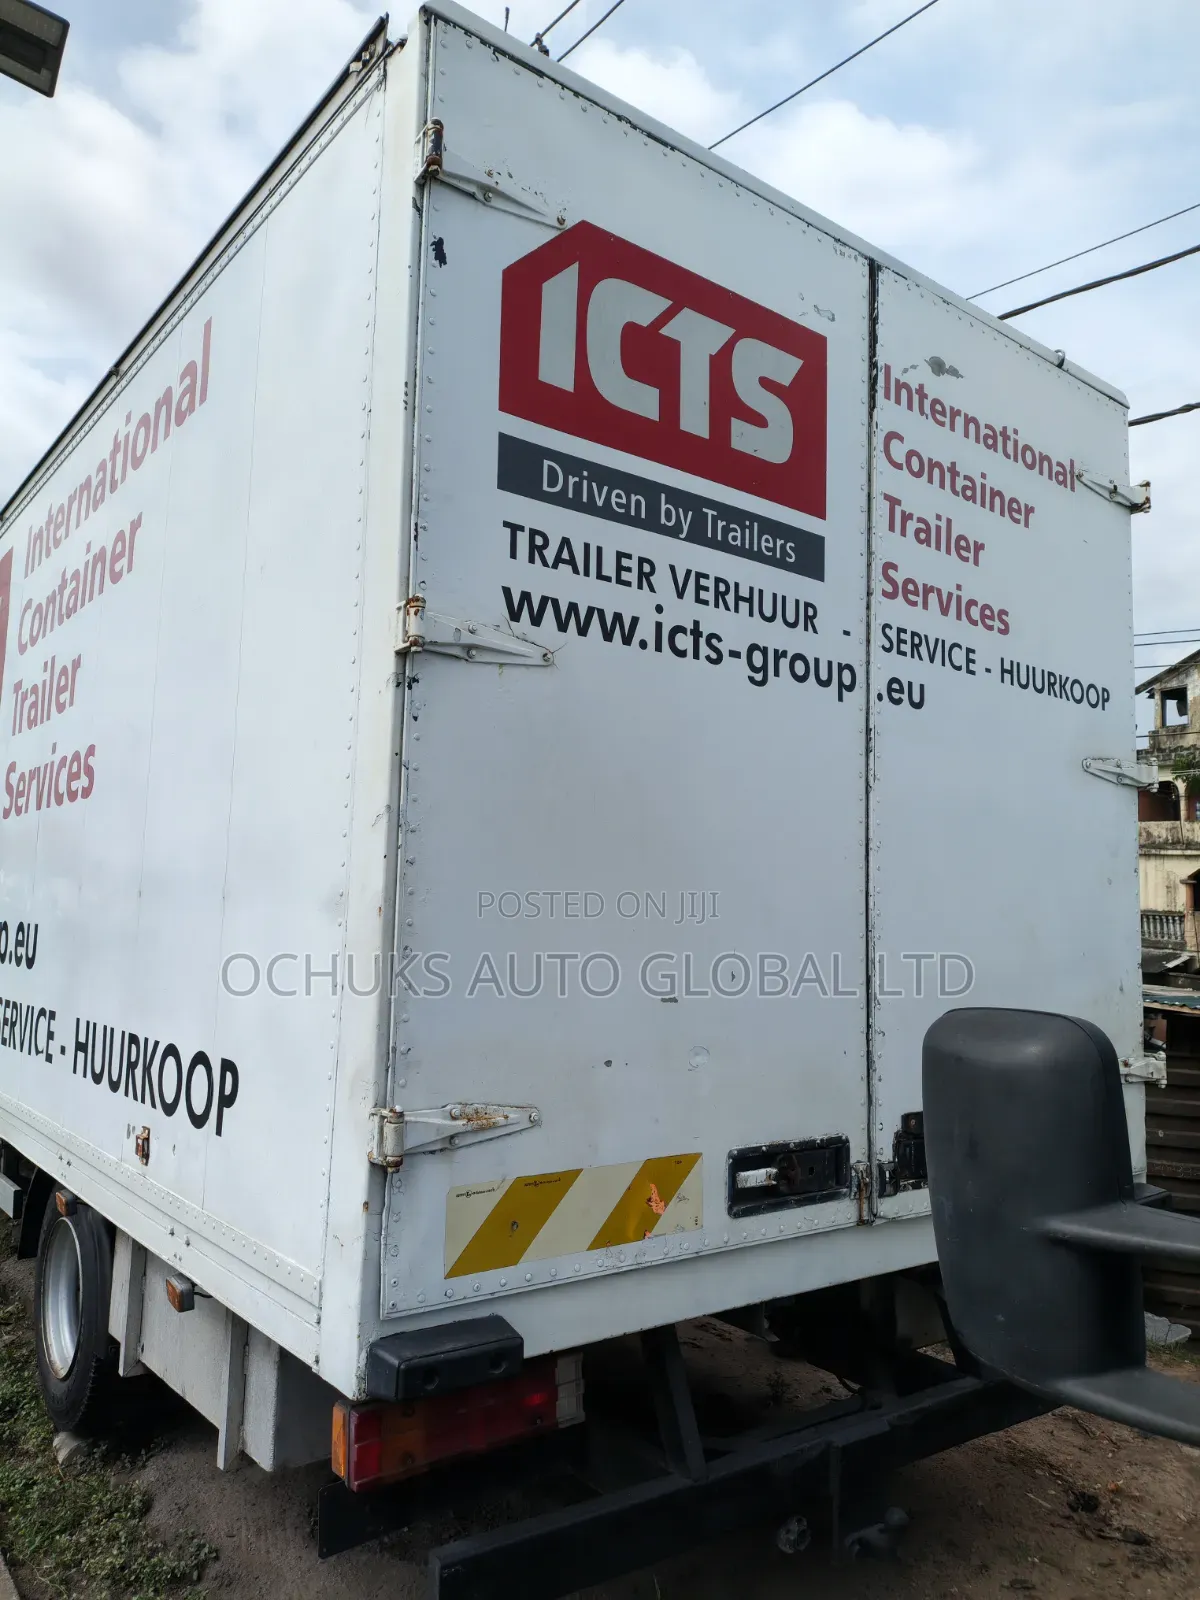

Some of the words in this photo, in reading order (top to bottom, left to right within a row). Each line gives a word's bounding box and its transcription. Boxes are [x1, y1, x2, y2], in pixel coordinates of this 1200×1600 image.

[538, 261, 804, 464] ICTS
[24, 316, 212, 579] International
[883, 363, 1076, 492] International
[883, 430, 1035, 529] Container
[542, 459, 646, 519] Driven
[660, 493, 693, 538] by
[703, 507, 796, 563] Trailers
[883, 493, 985, 567] Trailer
[18, 511, 142, 655] Container
[502, 520, 656, 594] TRAILER
[669, 563, 818, 635] VERHUUR
[881, 623, 976, 676] SERVICE
[1001, 656, 1110, 711] HUURKOOP
[881, 561, 1010, 635] Services
[12, 653, 81, 736] Trailer
[2, 742, 96, 820] Services
[0, 997, 56, 1064] ERVICE
[73, 1017, 239, 1137] HUURKOOP
